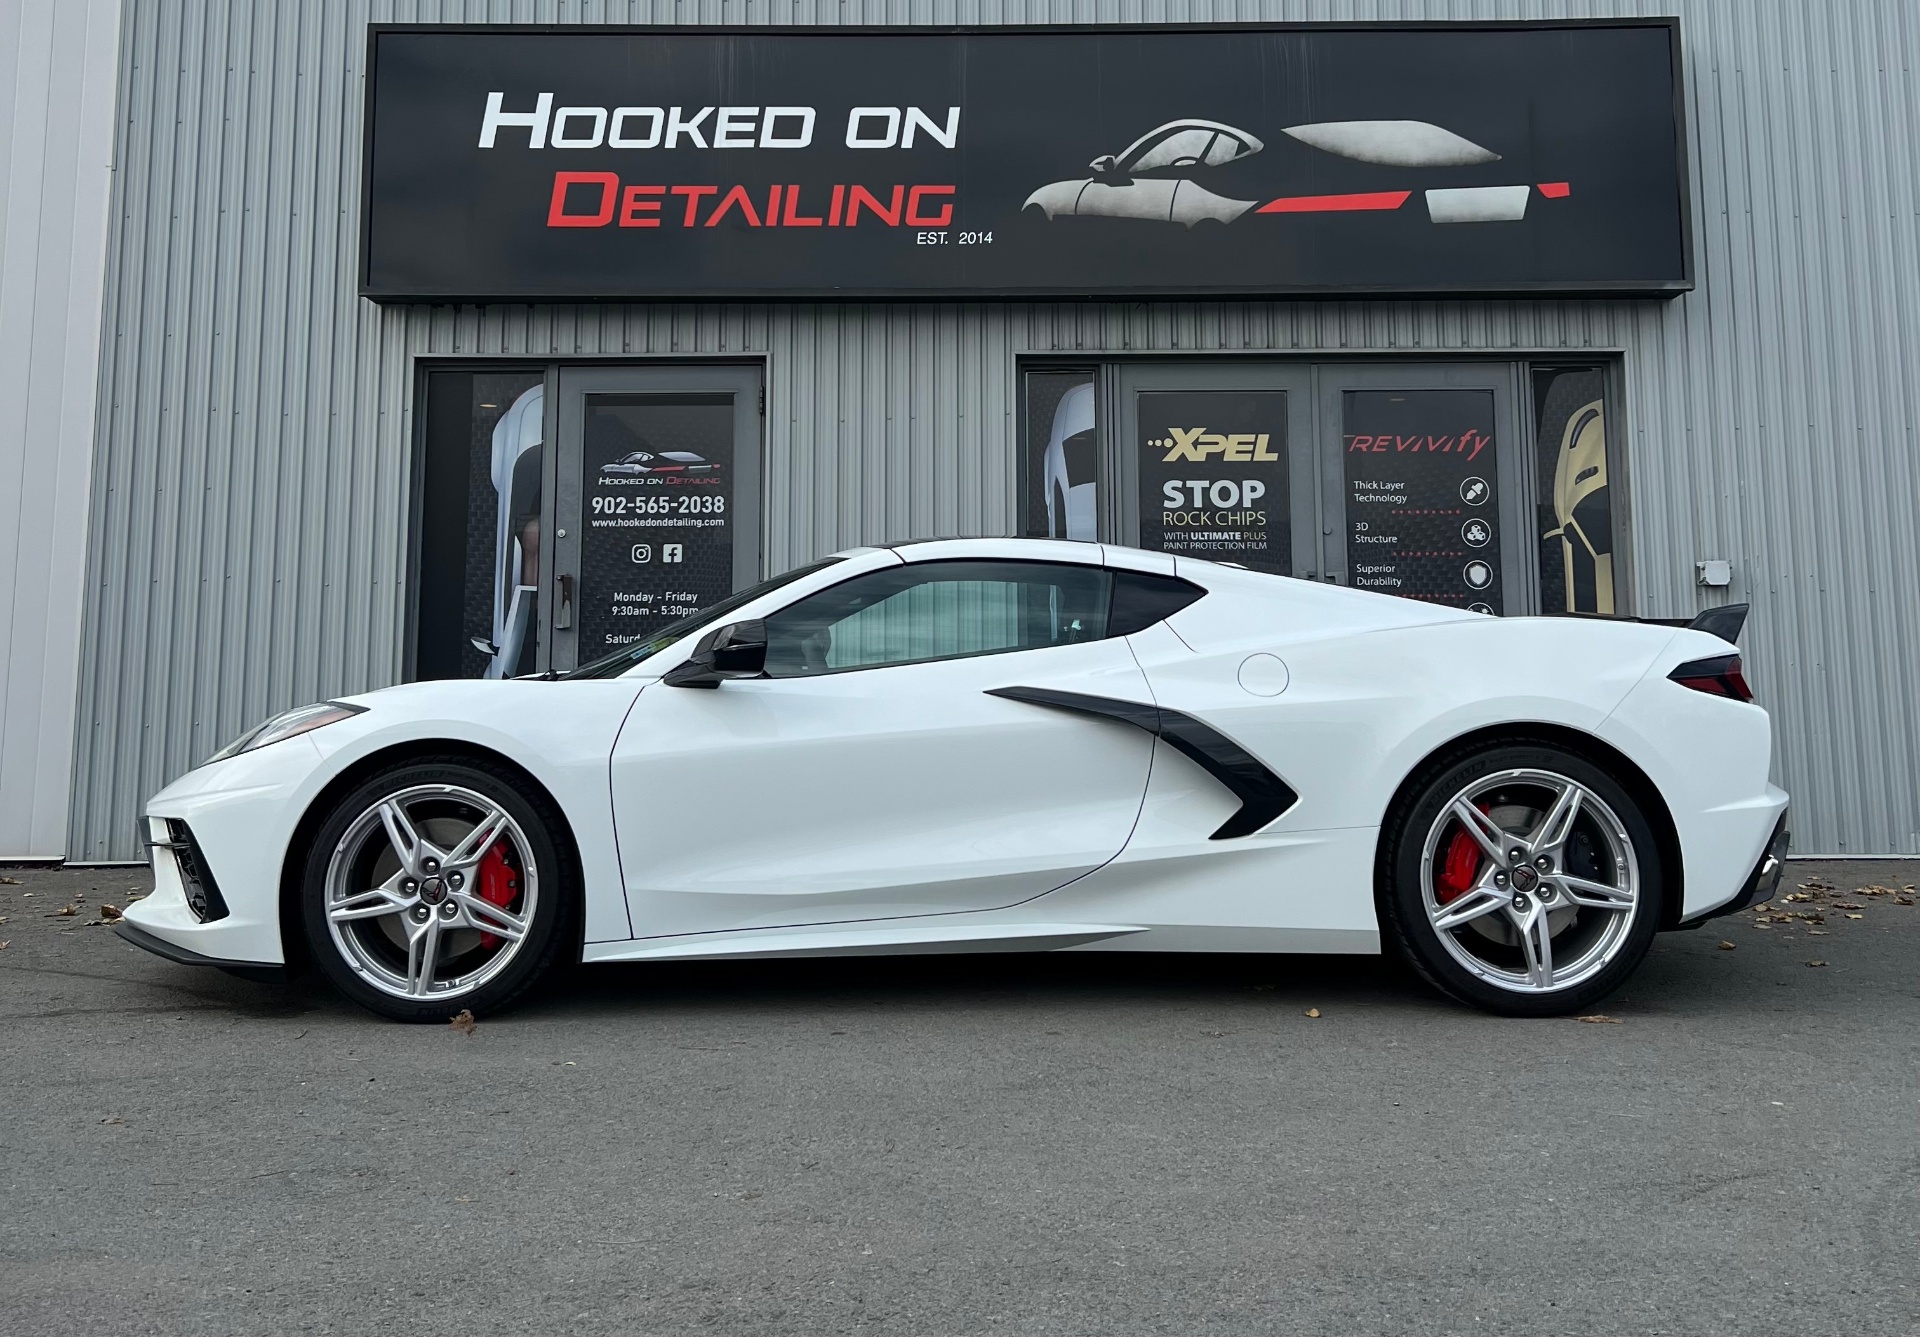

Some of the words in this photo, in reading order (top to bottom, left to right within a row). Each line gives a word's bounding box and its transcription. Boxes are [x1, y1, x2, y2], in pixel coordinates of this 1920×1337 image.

[478, 92, 816, 149] HOOKED
[845, 107, 961, 149] ON
[547, 171, 956, 227] DETAILING
[917, 232, 949, 245] EST.
[959, 232, 993, 245] 2014
[1162, 428, 1279, 461] XPEL
[598, 477, 644, 485] HOOKED
[666, 477, 721, 485] DETAILING
[1354, 481, 1379, 490] Thick
[1380, 482, 1405, 492] Layer
[1163, 480, 1266, 509] STOP
[1354, 494, 1407, 505] Technology
[592, 496, 725, 514] 902-565-2038
[592, 518, 725, 527] www.hookedondetailing.com
[1163, 511, 1211, 526] ROCK
[1215, 511, 1266, 526] CHIPS
[1355, 522, 1369, 531] 3D
[1164, 532, 1188, 540] WITH
[1191, 532, 1242, 540] ULTIMATE
[1244, 532, 1267, 540] PLUS
[1355, 535, 1397, 543] Structure
[1164, 542, 1188, 550] PAINT
[1190, 542, 1244, 550] PROTECTION
[1247, 542, 1267, 550] FILM
[1356, 564, 1395, 574] Superior
[1357, 577, 1402, 588] Durability
[614, 592, 654, 603] Monday
[665, 592, 698, 603] Friday
[612, 606, 649, 615] 9:30am
[661, 606, 699, 618] 5:30pm
